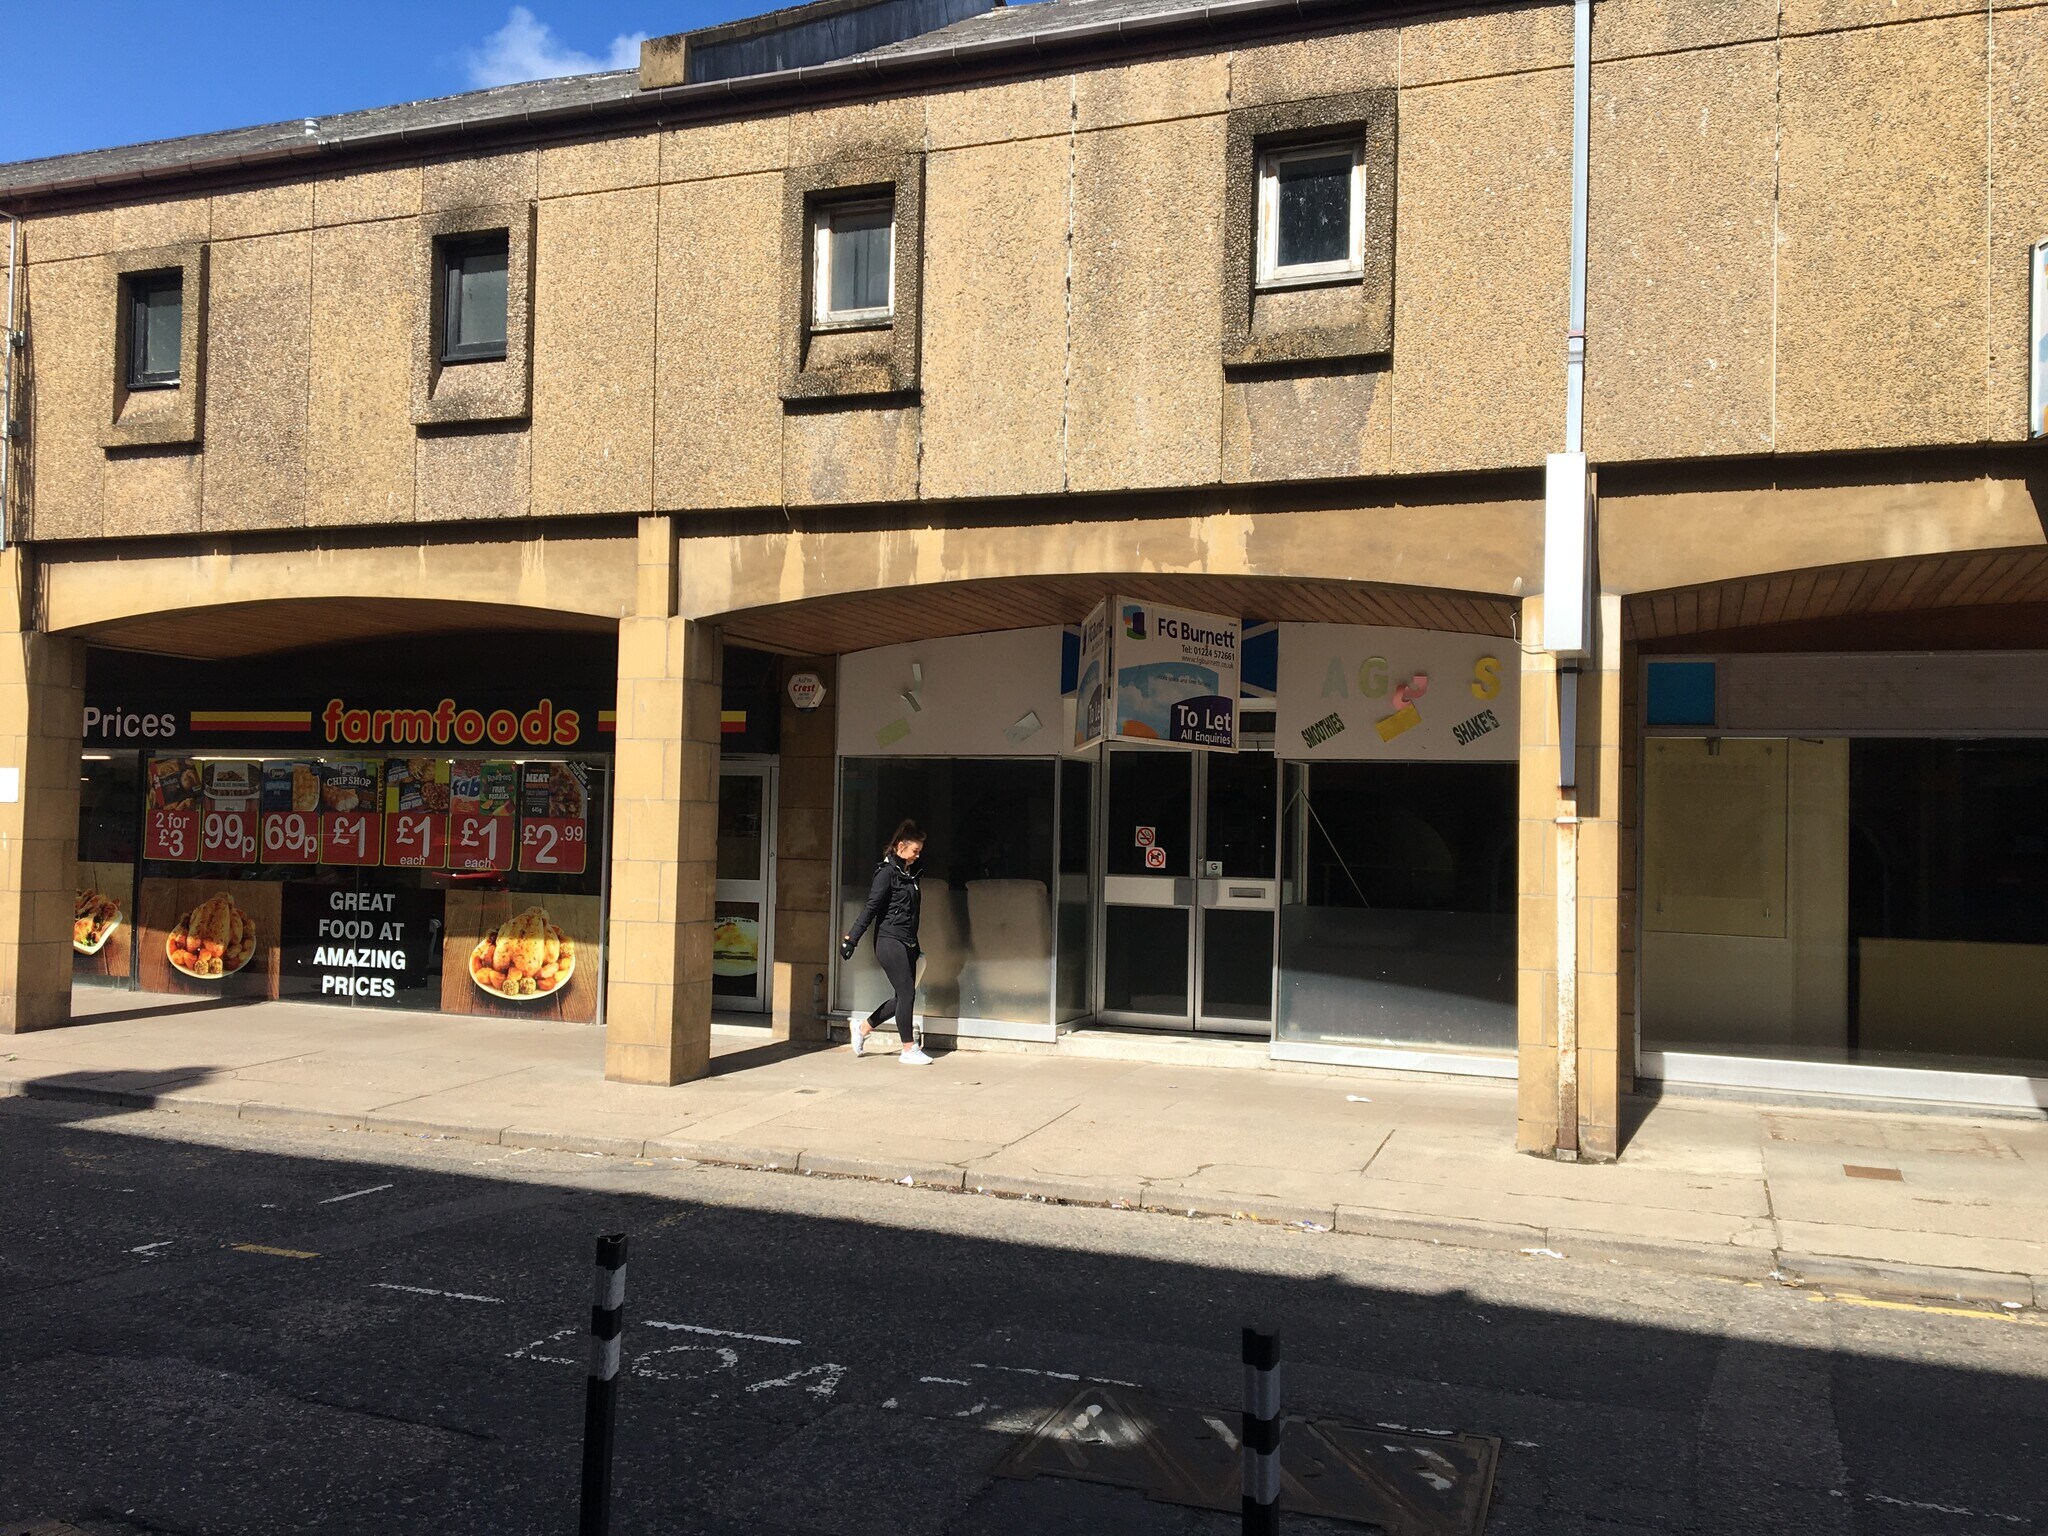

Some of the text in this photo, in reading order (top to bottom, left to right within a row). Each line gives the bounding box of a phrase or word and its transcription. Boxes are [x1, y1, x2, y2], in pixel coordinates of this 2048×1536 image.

[1158, 617, 1235, 648] FG Burnett
[1181, 645, 1193, 654] Tel:
[1194, 647, 1212, 657] 01224
[793, 684, 816, 692] Crest
[1471, 656, 1504, 700] S
[83, 706, 176, 738] Prices
[322, 698, 581, 746] farmfoods
[1177, 704, 1231, 732] To Let
[1301, 712, 1345, 749] SMOOTHIES
[1452, 709, 1500, 746] SHAKE'S
[1180, 729, 1231, 745] All Enquiries
[326, 776, 372, 788] CHIP SHOP
[452, 777, 480, 798] fab
[525, 773, 550, 783] MEAT
[155, 812, 190, 829] 2 for
[158, 829, 184, 857] £3
[204, 813, 255, 858] 99p
[264, 813, 318, 859] 69p
[332, 816, 366, 858] £1
[396, 816, 431, 858] £1
[460, 818, 498, 860] £1
[523, 824, 584, 864] £2.99
[399, 855, 426, 866] each
[464, 857, 492, 868] each
[1210, 862, 1218, 871] G
[329, 891, 396, 912] GREAT
[318, 918, 405, 941] FOOD AT
[312, 946, 406, 970] AMAZING
[321, 975, 396, 998] PRICES
